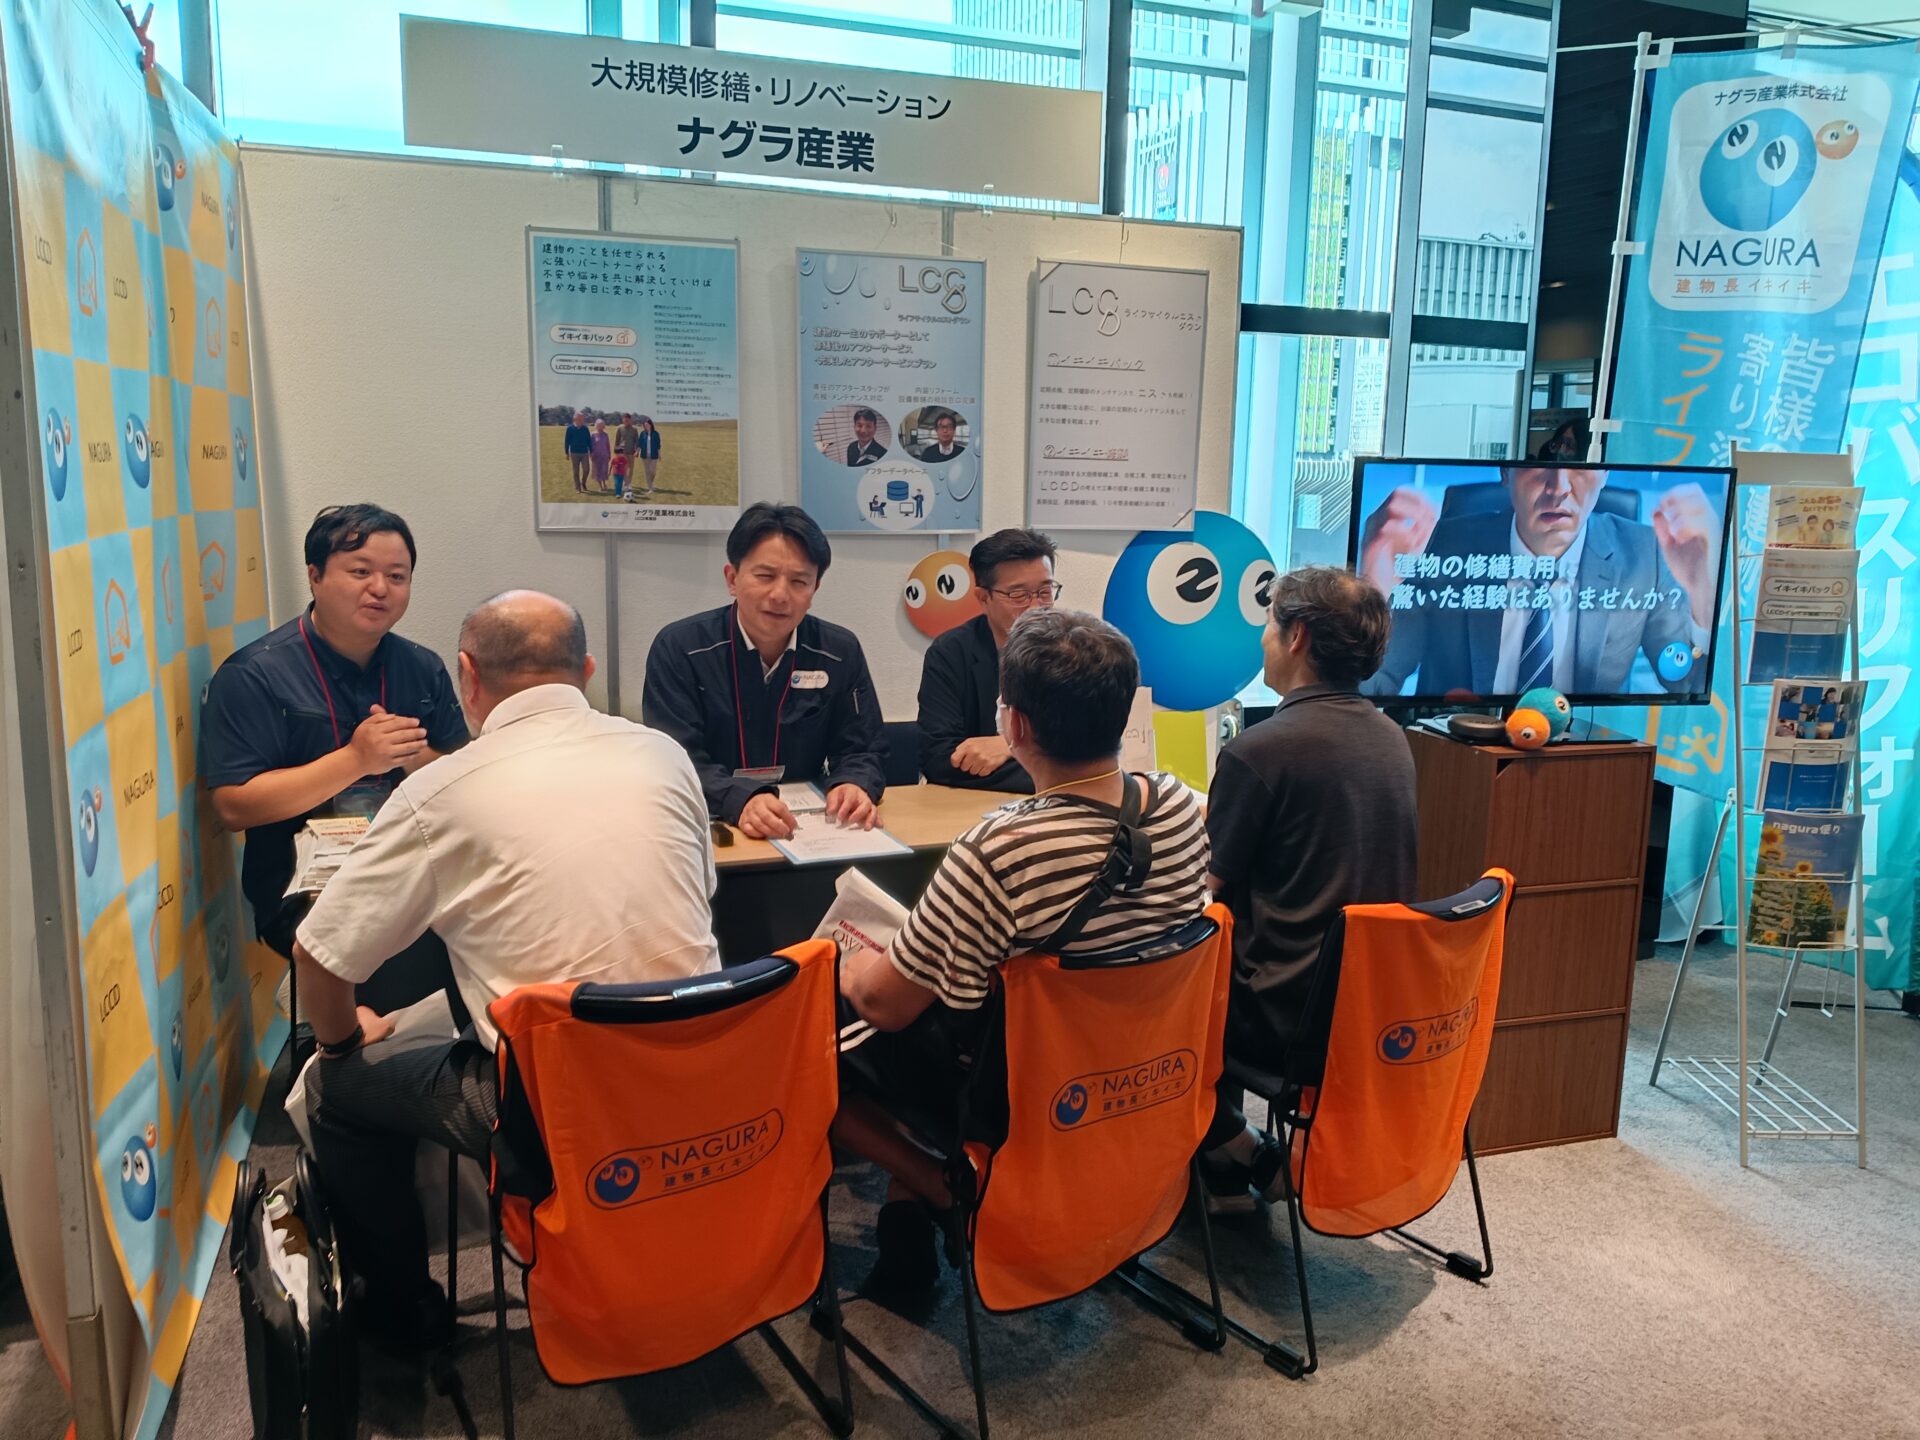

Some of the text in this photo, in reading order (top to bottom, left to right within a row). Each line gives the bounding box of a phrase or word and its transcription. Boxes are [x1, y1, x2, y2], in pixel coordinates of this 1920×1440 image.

[590, 57, 952, 122] 大規模修繕・リノベーション
[1714, 82, 1849, 106] ナグラ産業株式会社
[677, 117, 875, 173] ナグラ産業
[542, 243, 666, 261] 建物のことを任せられる
[542, 255, 666, 273] 心強いパートナーがいる
[1675, 238, 1821, 268] NAGURA
[543, 269, 712, 287] 不安や悩みを共に解決していけば
[544, 281, 677, 298] 豊かな毎日に変わっていく
[1675, 277, 1812, 295] 建物長イキイキ
[559, 332, 613, 343] イキイキパック
[1390, 585, 1683, 612] 驚いた経験はありませんか？
[1772, 821, 1841, 834] nagura便り
[158, 884, 174, 910] CCD
[1102, 1056, 1185, 1095] NAGURA
[660, 1120, 769, 1170] NAGURA
